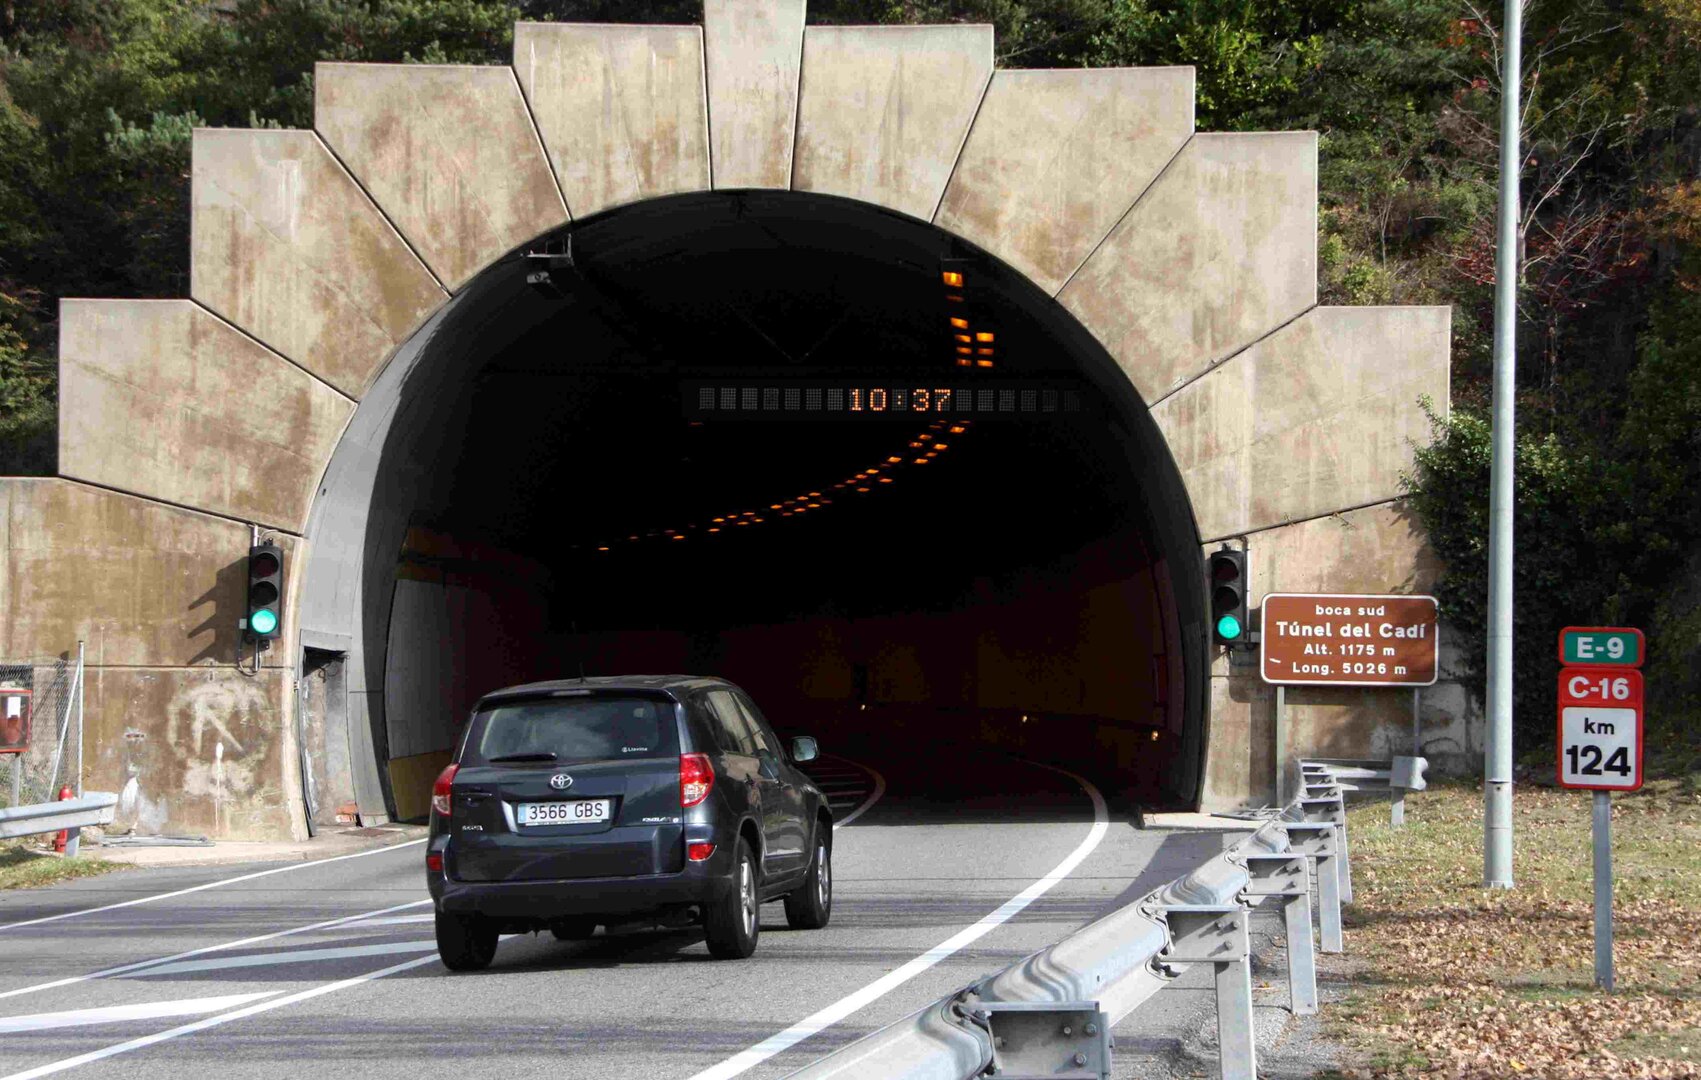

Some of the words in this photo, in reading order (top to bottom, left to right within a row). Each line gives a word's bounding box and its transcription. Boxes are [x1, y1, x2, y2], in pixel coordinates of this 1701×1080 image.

[851, 388, 951, 411] 10:37
[1315, 605, 1351, 616] boca
[1358, 605, 1385, 616] sud
[1276, 621, 1332, 637] Túnel
[1340, 623, 1371, 638] del
[1379, 623, 1426, 638] Cadí
[1304, 643, 1333, 655] Alt.
[1340, 644, 1375, 656] 1175
[1383, 646, 1396, 656] m
[1577, 637, 1624, 659] E-9
[1292, 662, 1335, 675] Long.
[1342, 663, 1387, 675] 5026
[1394, 665, 1407, 675] m
[1568, 676, 1629, 700] C-16
[1584, 717, 1615, 735] km
[1566, 745, 1631, 776] 124
[529, 804, 567, 820] 3566
[574, 802, 603, 818] GBS
